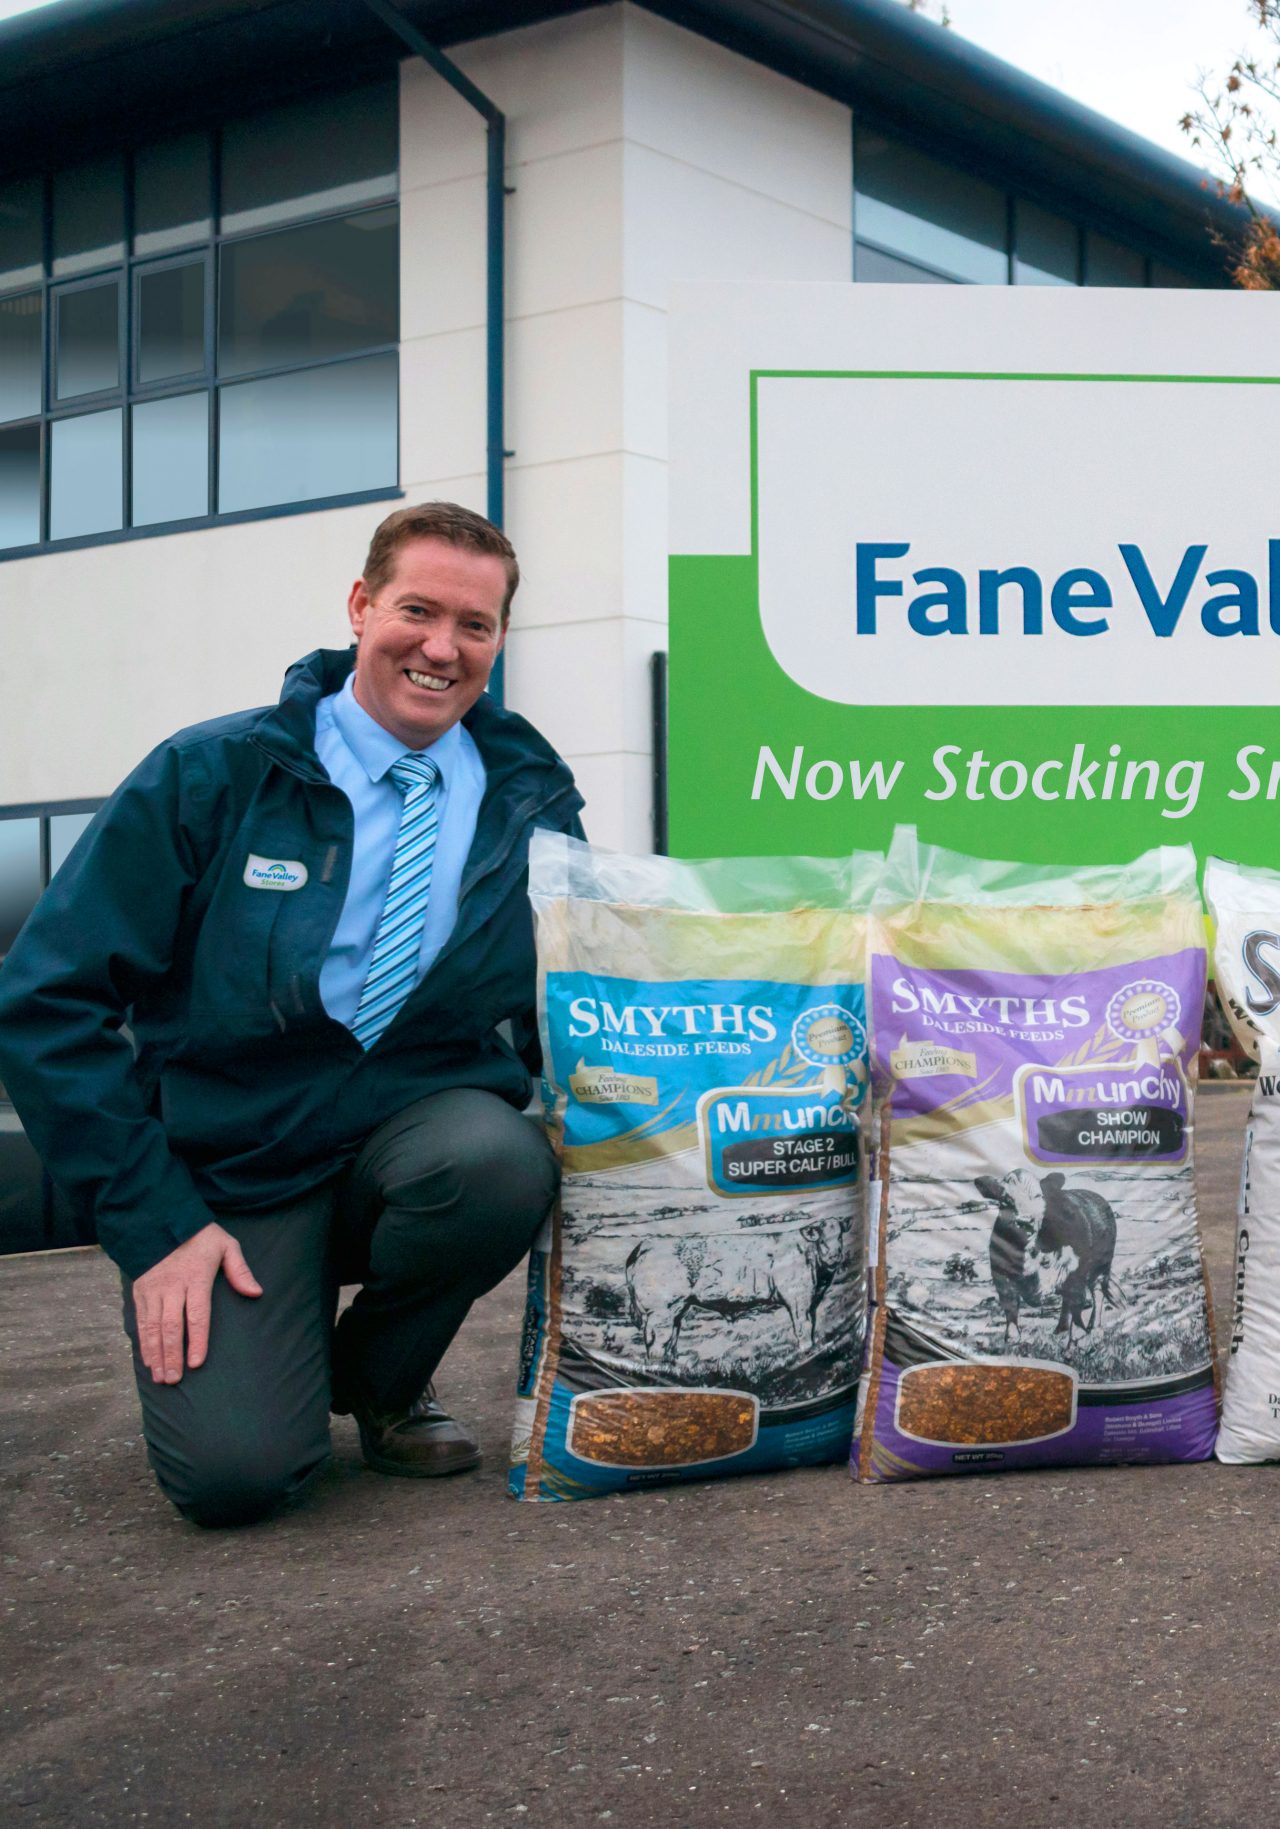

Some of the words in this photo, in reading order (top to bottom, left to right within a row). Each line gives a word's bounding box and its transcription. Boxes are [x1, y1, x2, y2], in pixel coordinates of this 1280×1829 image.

[751, 746, 905, 801] Now
[924, 744, 1205, 819] Stocking
[892, 977, 1090, 1028] SMYTHS
[569, 997, 777, 1042] SMYTHS
[922, 1014, 1006, 1036] DALESIDE
[1010, 1029, 1065, 1042] FEEDS
[601, 1038, 690, 1057] DALESIDE
[694, 1041, 752, 1056] FEEDS
[894, 1056, 971, 1071] CHAMPIONS
[575, 1083, 653, 1097] CHAMPIONS
[1032, 1069, 1180, 1109] Mmunchy
[1097, 1111, 1147, 1126] SHOW
[773, 1138, 824, 1156] STAGE
[826, 1137, 835, 1151] 2
[1078, 1130, 1160, 1146] CHAMPION
[728, 1161, 786, 1178] SUPER
